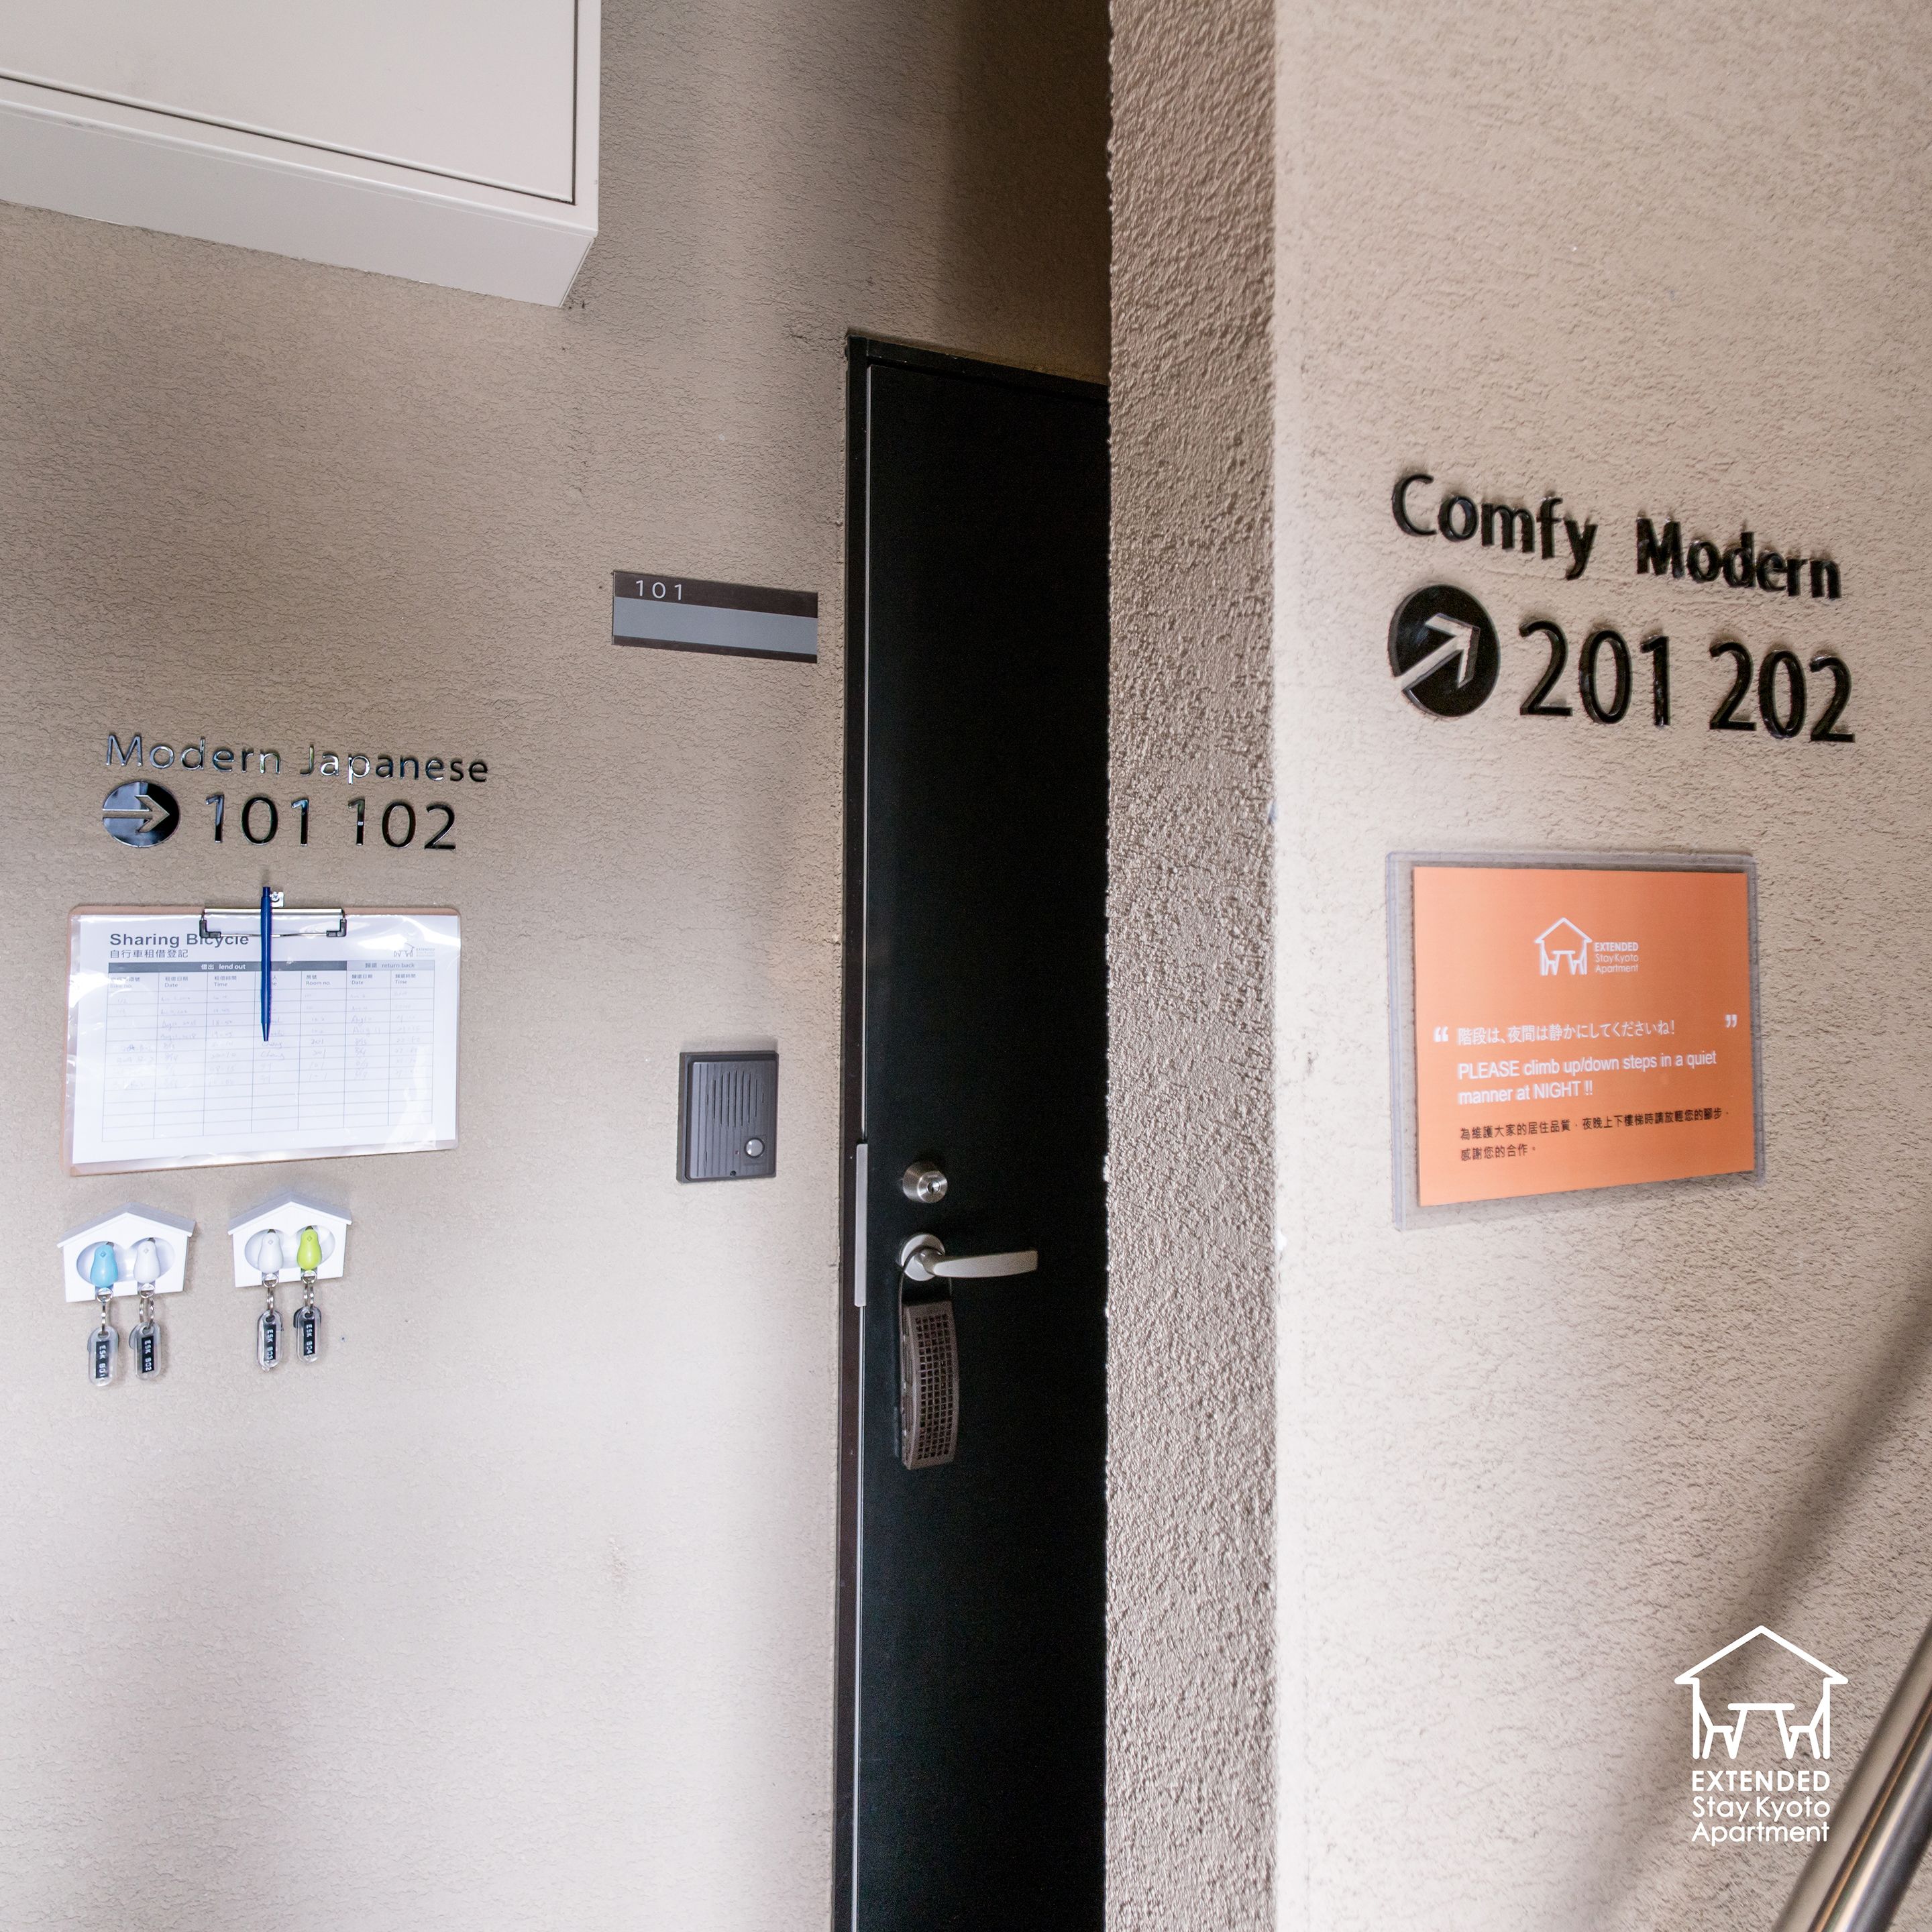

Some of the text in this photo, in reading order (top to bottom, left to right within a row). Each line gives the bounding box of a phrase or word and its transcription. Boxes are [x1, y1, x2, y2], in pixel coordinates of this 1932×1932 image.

[1391, 474, 1842, 599] Comfy Modern
[636, 580, 683, 600] 101
[1519, 619, 1856, 743] 201 202
[106, 734, 489, 785] Modern Japanese
[205, 794, 457, 851] 101 102
[110, 933, 180, 948] Sharing
[1595, 942, 1639, 951] EXTENDED
[111, 949, 189, 958] 自行車租借登記
[1595, 953, 1639, 964] Stay Kyoto
[1595, 964, 1639, 974] Apartment
[1458, 1050, 1717, 1080] PLEASE climb up/down steps in a quiet
[1458, 1087, 1513, 1106] manner
[1515, 1086, 1531, 1101] at
[1534, 1080, 1582, 1099] NIGHT
